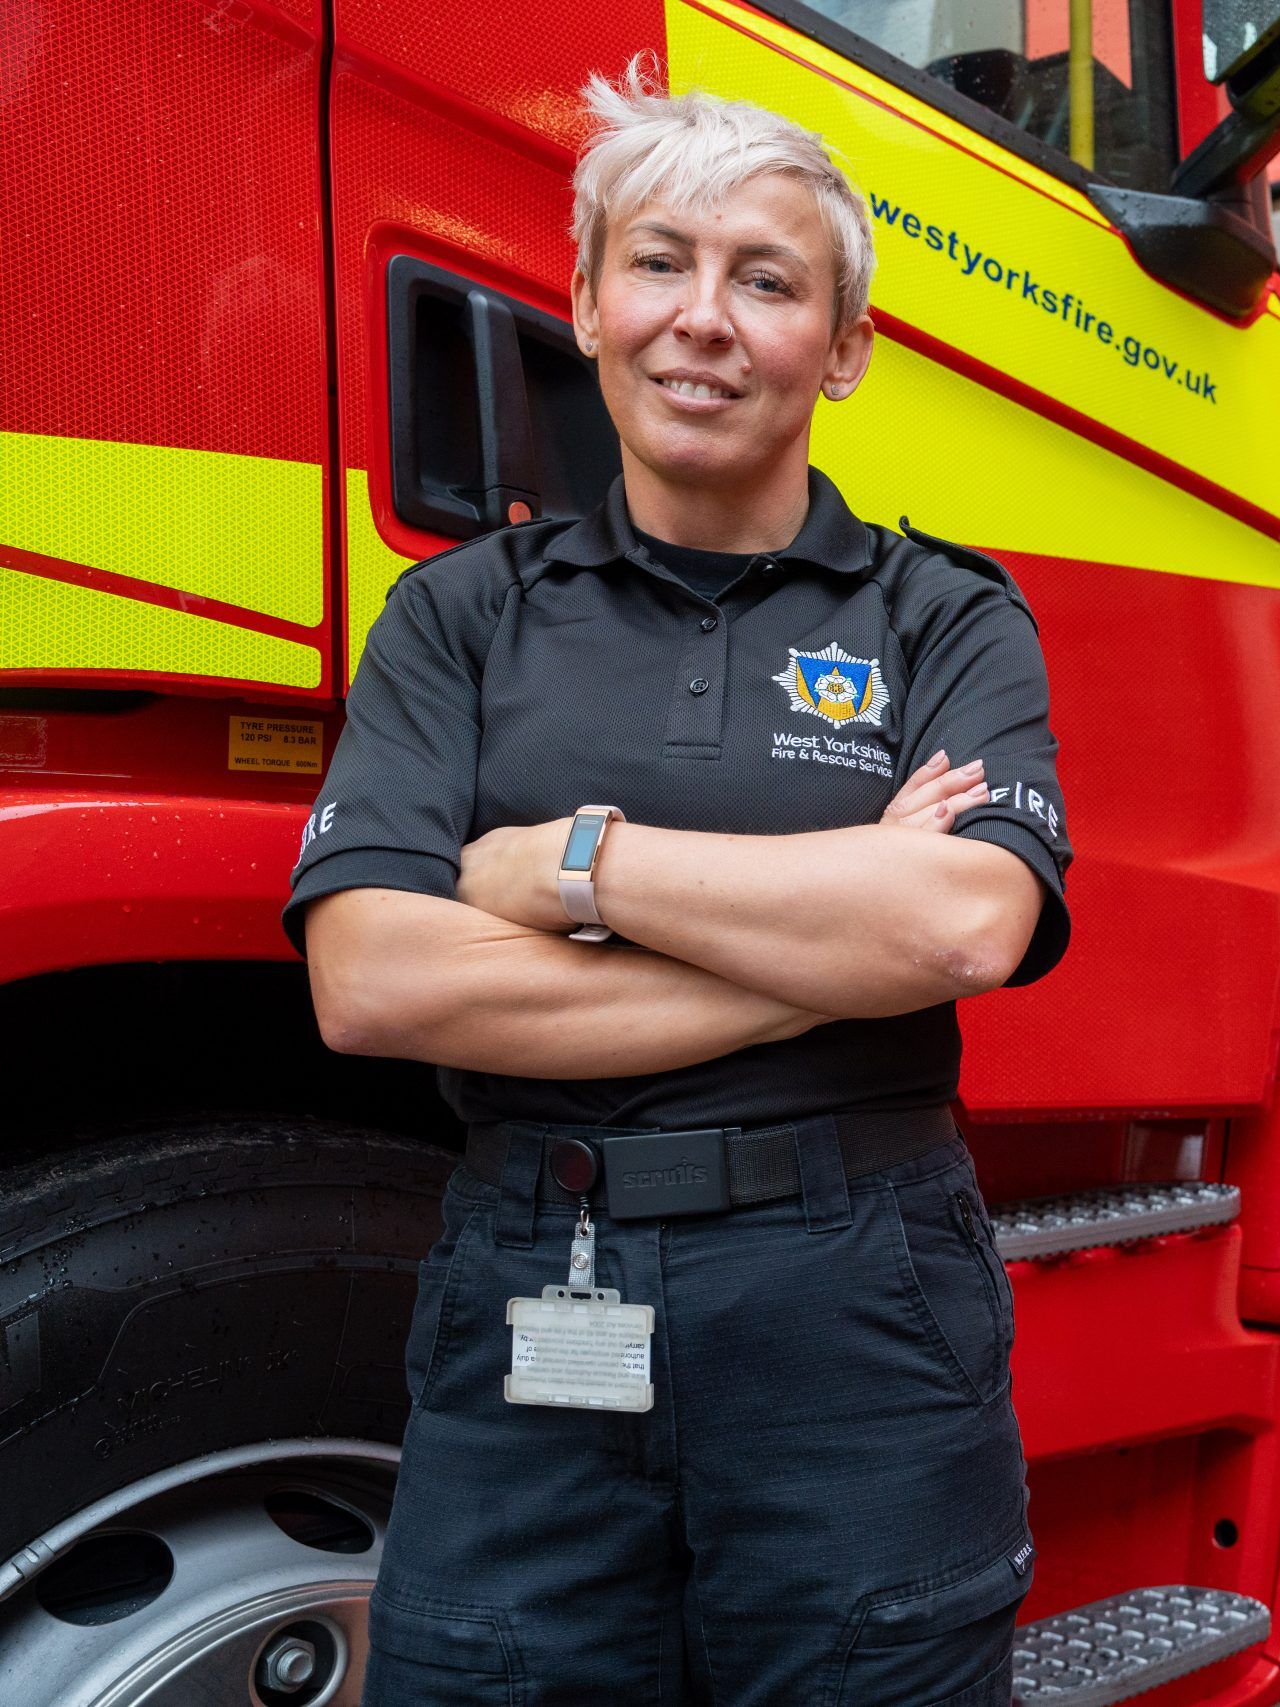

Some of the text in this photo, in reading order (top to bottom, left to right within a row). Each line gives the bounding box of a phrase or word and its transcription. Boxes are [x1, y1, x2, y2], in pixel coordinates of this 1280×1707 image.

[868, 192, 1217, 404] westyorksfire.gov.uk
[240, 721, 315, 734] TYRE PRESSURE
[240, 733, 255, 742] 120
[257, 734, 272, 743] PSI
[298, 736, 317, 745] BAR
[234, 756, 260, 766] WHEEL
[262, 758, 291, 767] TORQUE
[771, 747, 893, 778] Fire & Rescue Service
[773, 732, 892, 765] West Yorkshire
[989, 781, 1059, 838] FIRE
